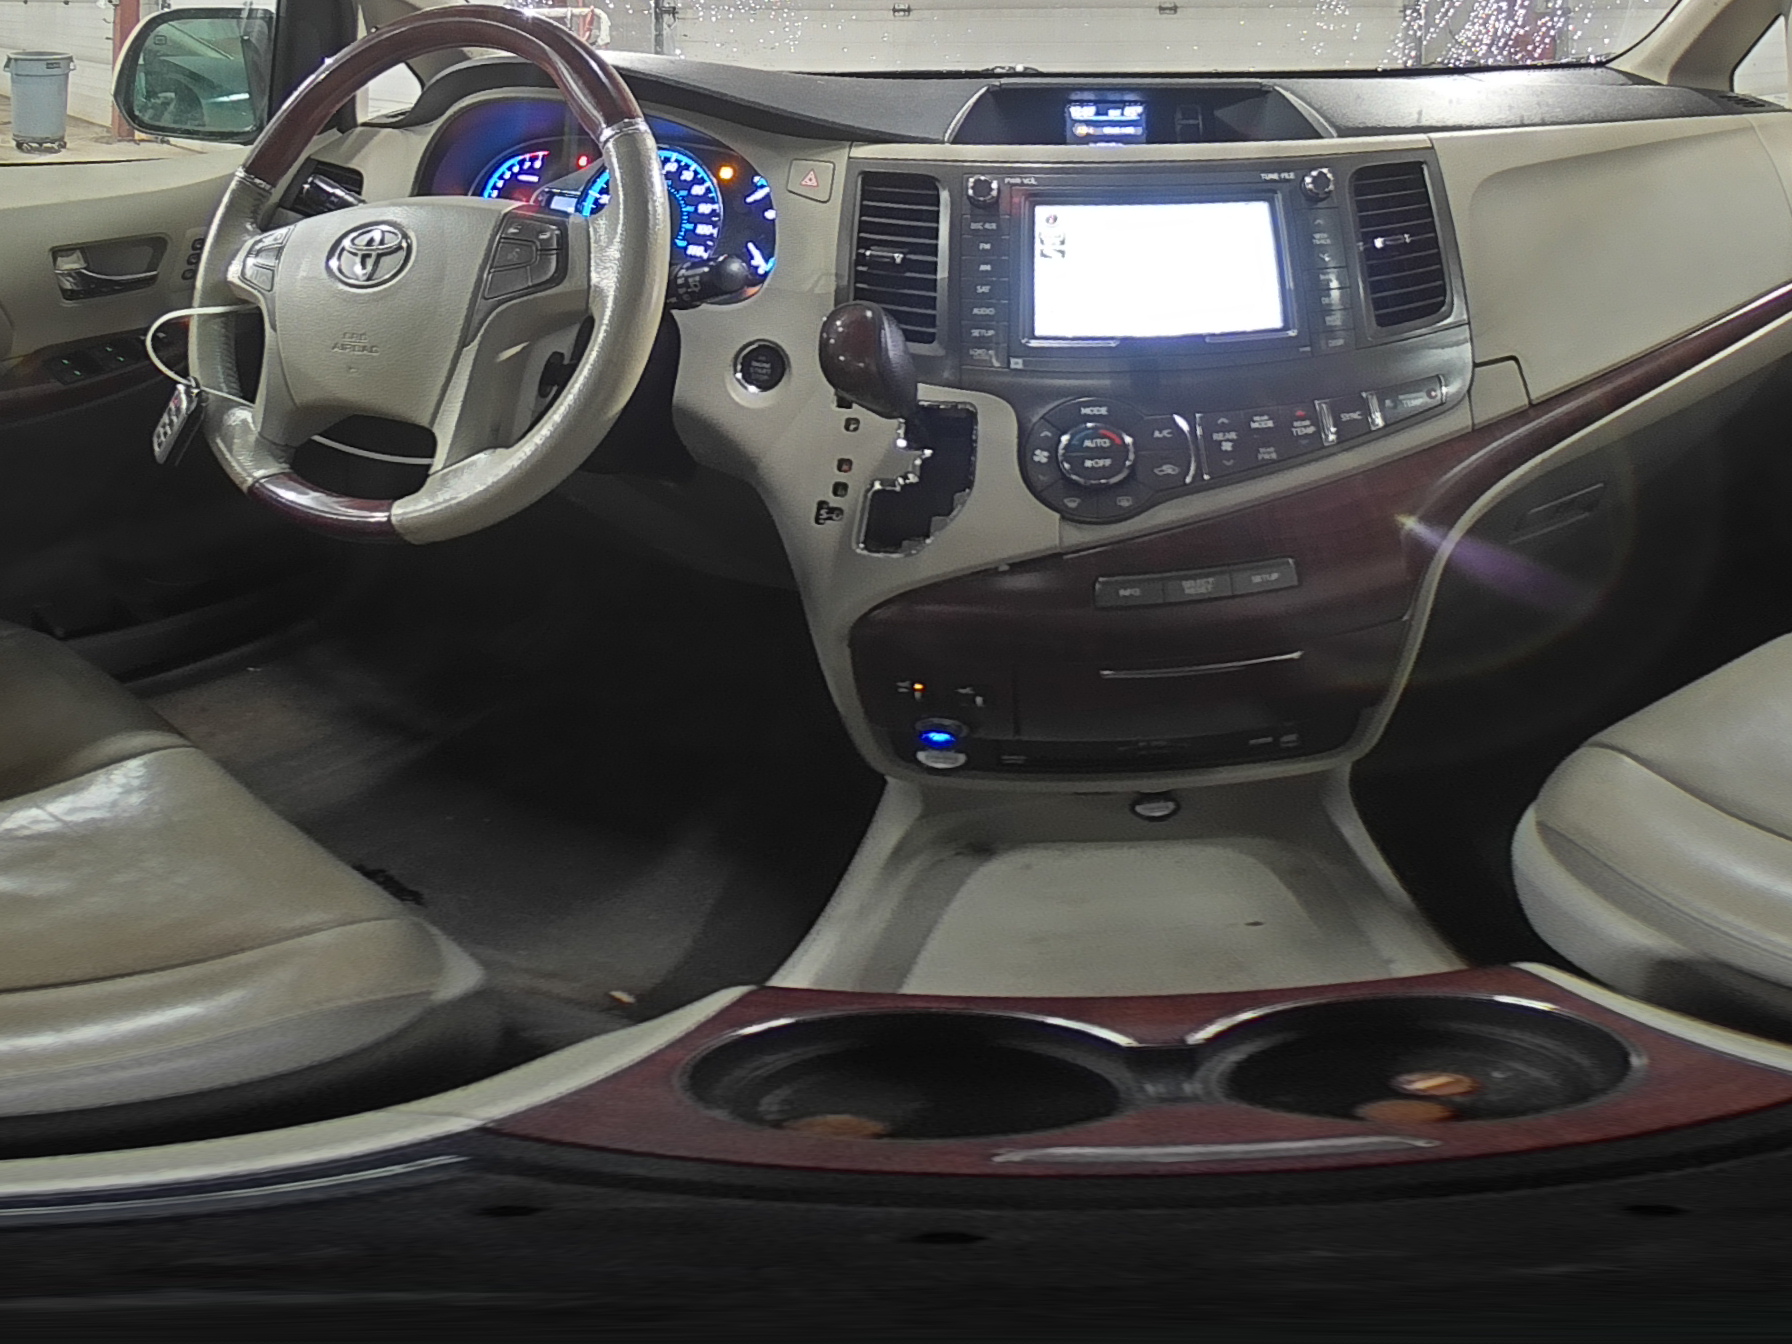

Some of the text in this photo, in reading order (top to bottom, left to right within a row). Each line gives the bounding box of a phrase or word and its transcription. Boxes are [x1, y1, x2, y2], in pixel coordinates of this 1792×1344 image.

[976, 285, 991, 294] SAT
[1080, 407, 1108, 415] MODE
[1340, 411, 1363, 422] SYNC
[1153, 429, 1173, 438] A/C
[1292, 426, 1316, 436] TEMP
[1212, 431, 1238, 441] REAR
[1083, 439, 1110, 448] AUTO
